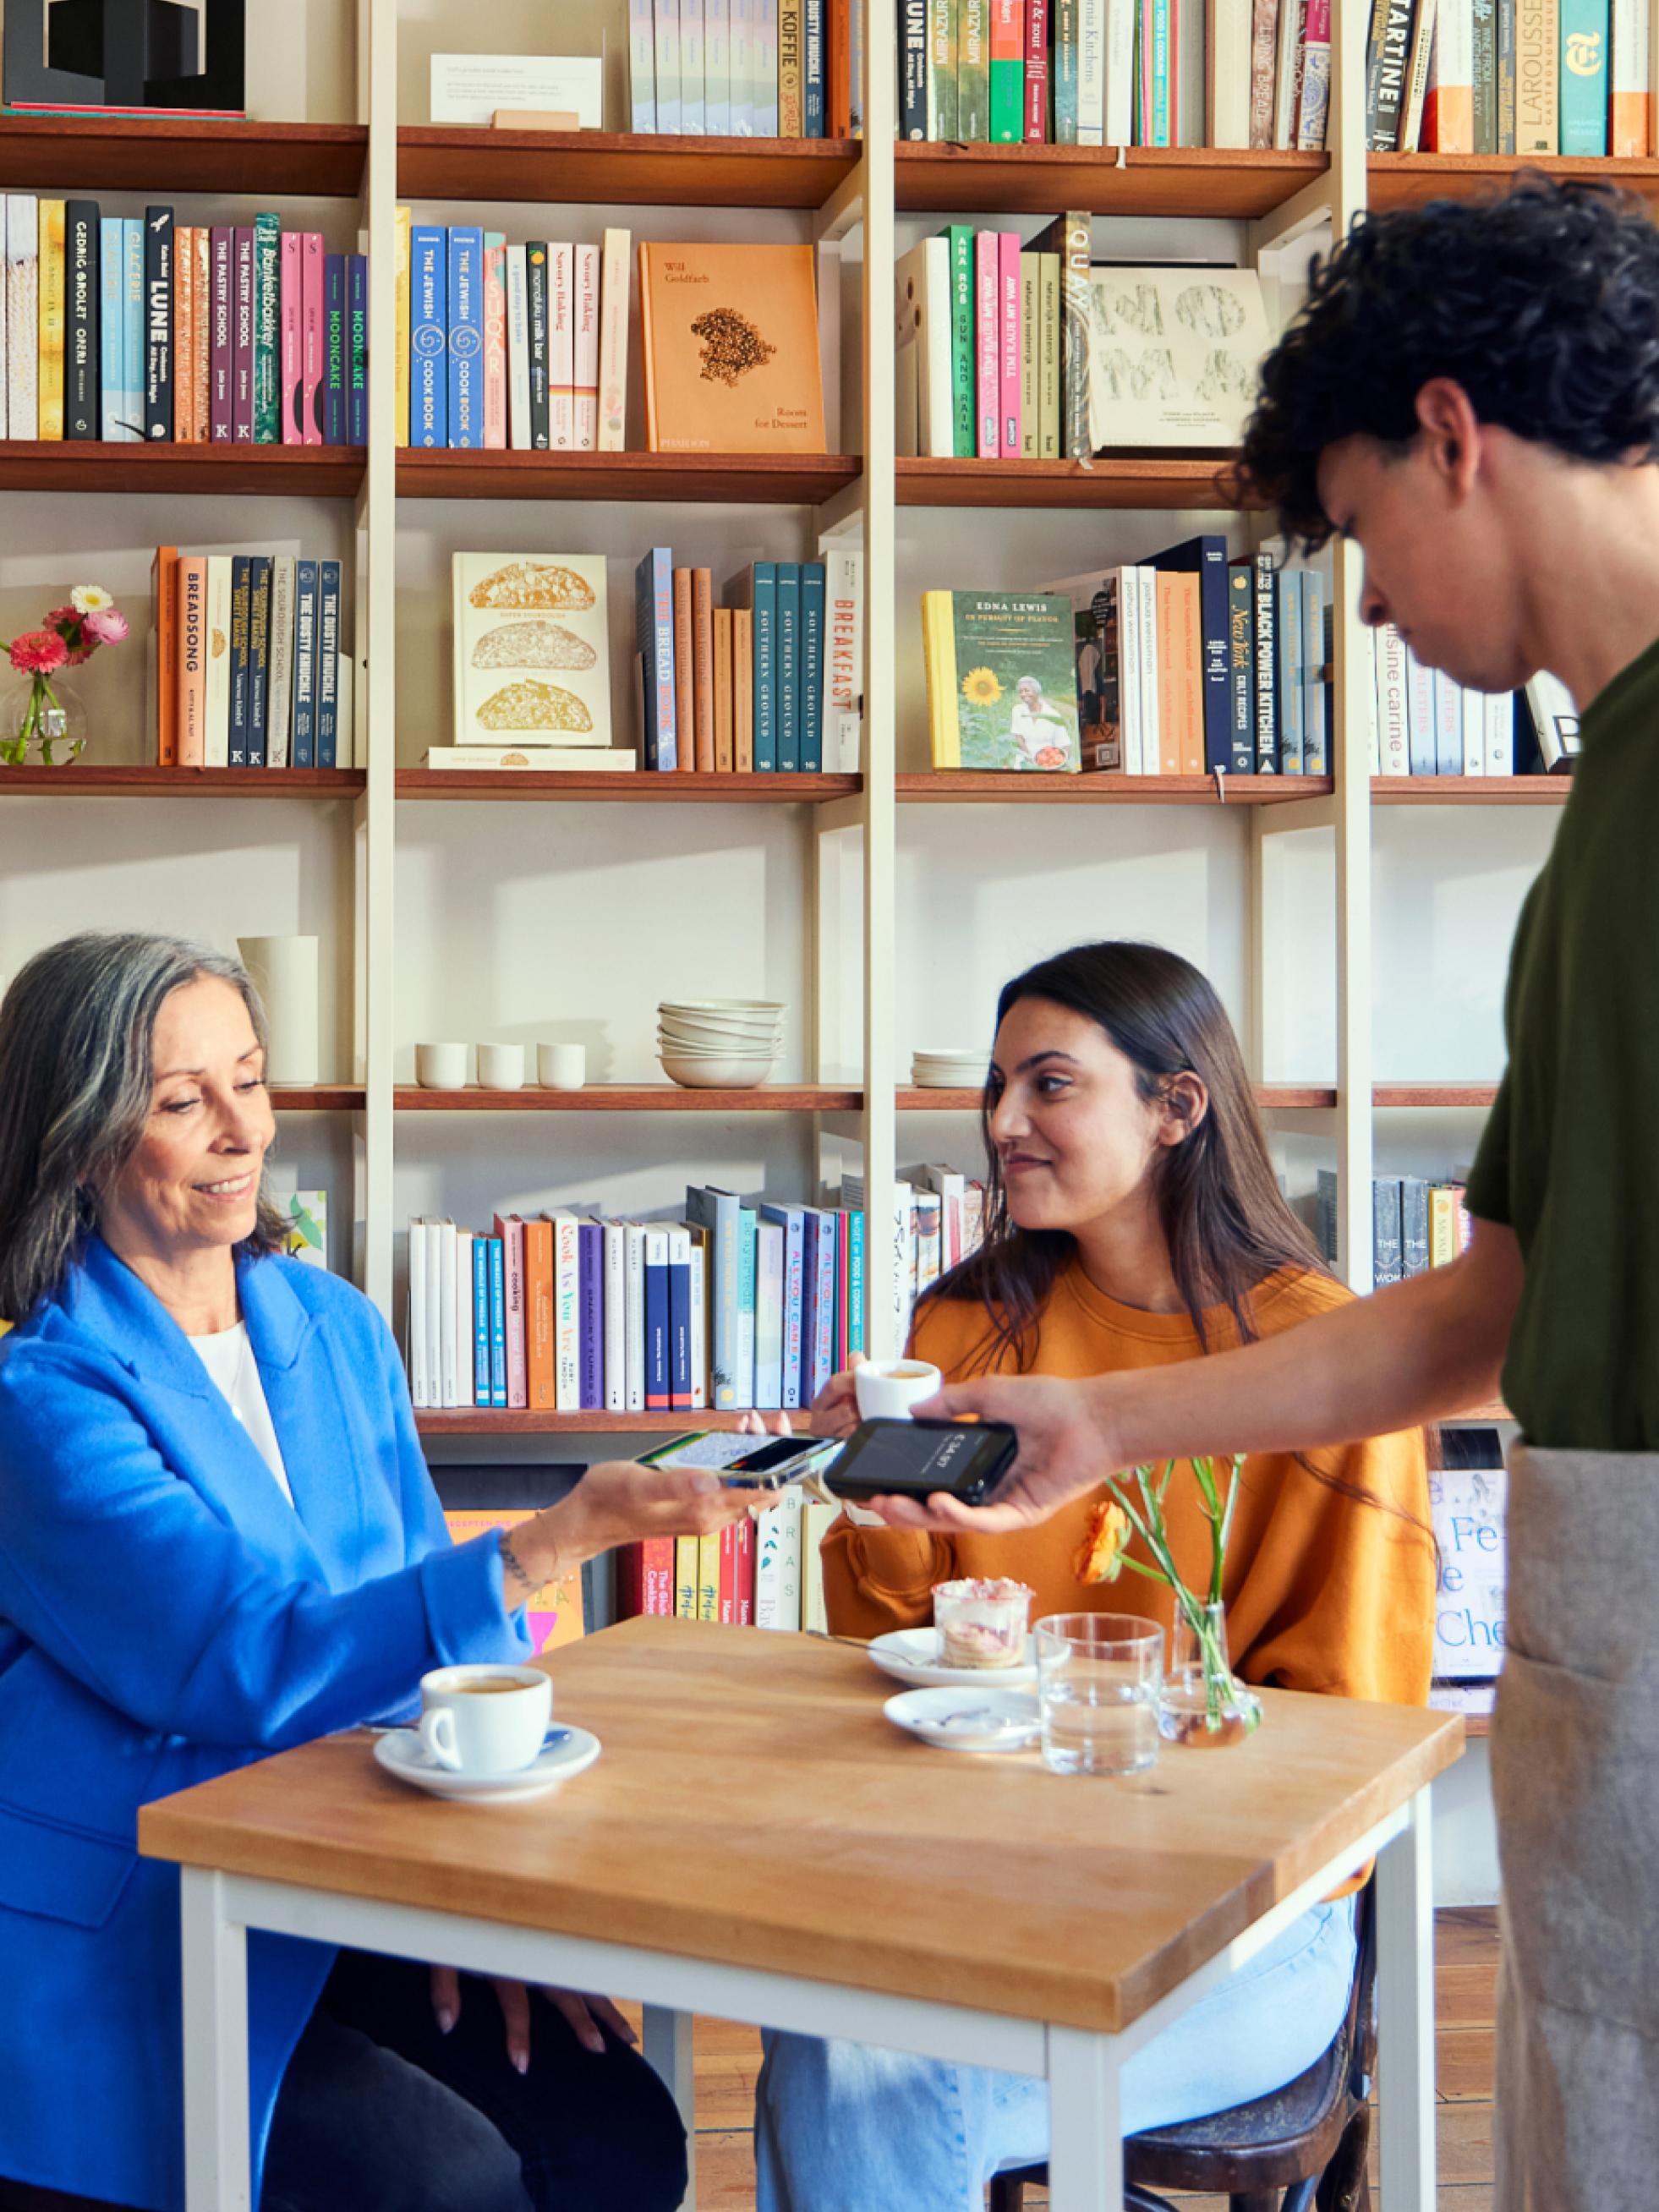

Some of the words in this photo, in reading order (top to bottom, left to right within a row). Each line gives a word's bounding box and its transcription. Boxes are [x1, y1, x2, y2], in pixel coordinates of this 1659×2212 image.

[782, 11, 797, 68] KOFFIE
[423, 250, 433, 274] THE
[460, 250, 469, 274] THE
[1070, 229, 1091, 312] QUAY
[151, 281, 168, 342] LUNE
[423, 275, 433, 320] JEWISH
[460, 276, 469, 320] JEWISH
[216, 304, 227, 348] SCHOOL
[239, 304, 249, 348] SCHOOL
[330, 310, 340, 390] MOONCAKE
[353, 310, 364, 390] MOONCAKE
[186, 572, 199, 674] BREADSONG
[976, 601, 1008, 610] EDNA
[1011, 603, 1048, 612] LEWIS
[1231, 604, 1250, 640] New
[1257, 594, 1273, 639] BLACK
[658, 626, 671, 681] BREAD
[831, 600, 855, 711] BREAKFAST
[1257, 641, 1273, 691] POWER
[1257, 692, 1273, 754] KITCHEN
[1388, 687, 1405, 752] carine
[1377, 1238, 1400, 1249] THE
[1404, 1238, 1427, 1249] THE
[512, 1271, 523, 1311] cooking
